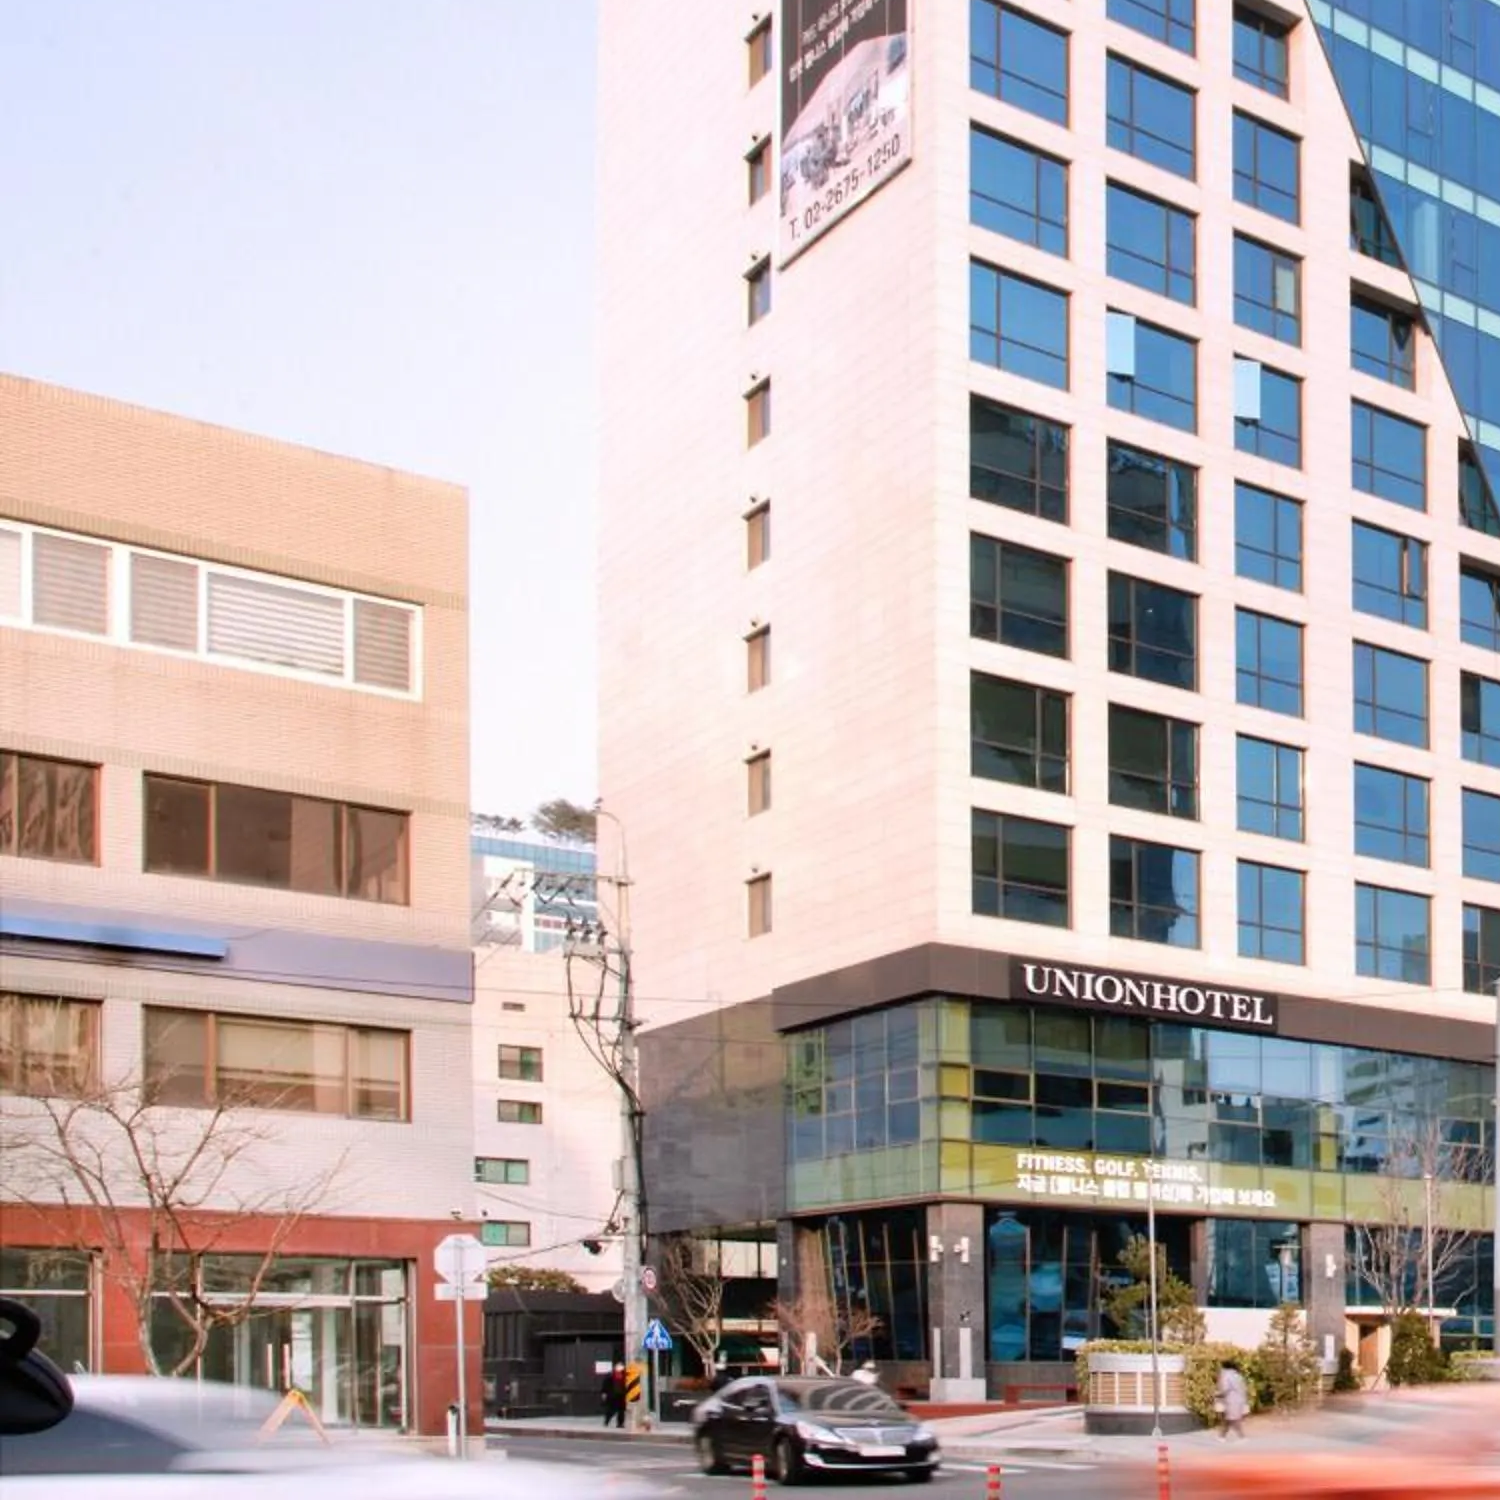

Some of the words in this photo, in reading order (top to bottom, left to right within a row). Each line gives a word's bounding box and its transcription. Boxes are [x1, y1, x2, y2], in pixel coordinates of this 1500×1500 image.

[788, 220, 801, 241] T.
[804, 133, 901, 230] 02-2675-1250
[1023, 963, 1273, 1025] UNIONHOTEL
